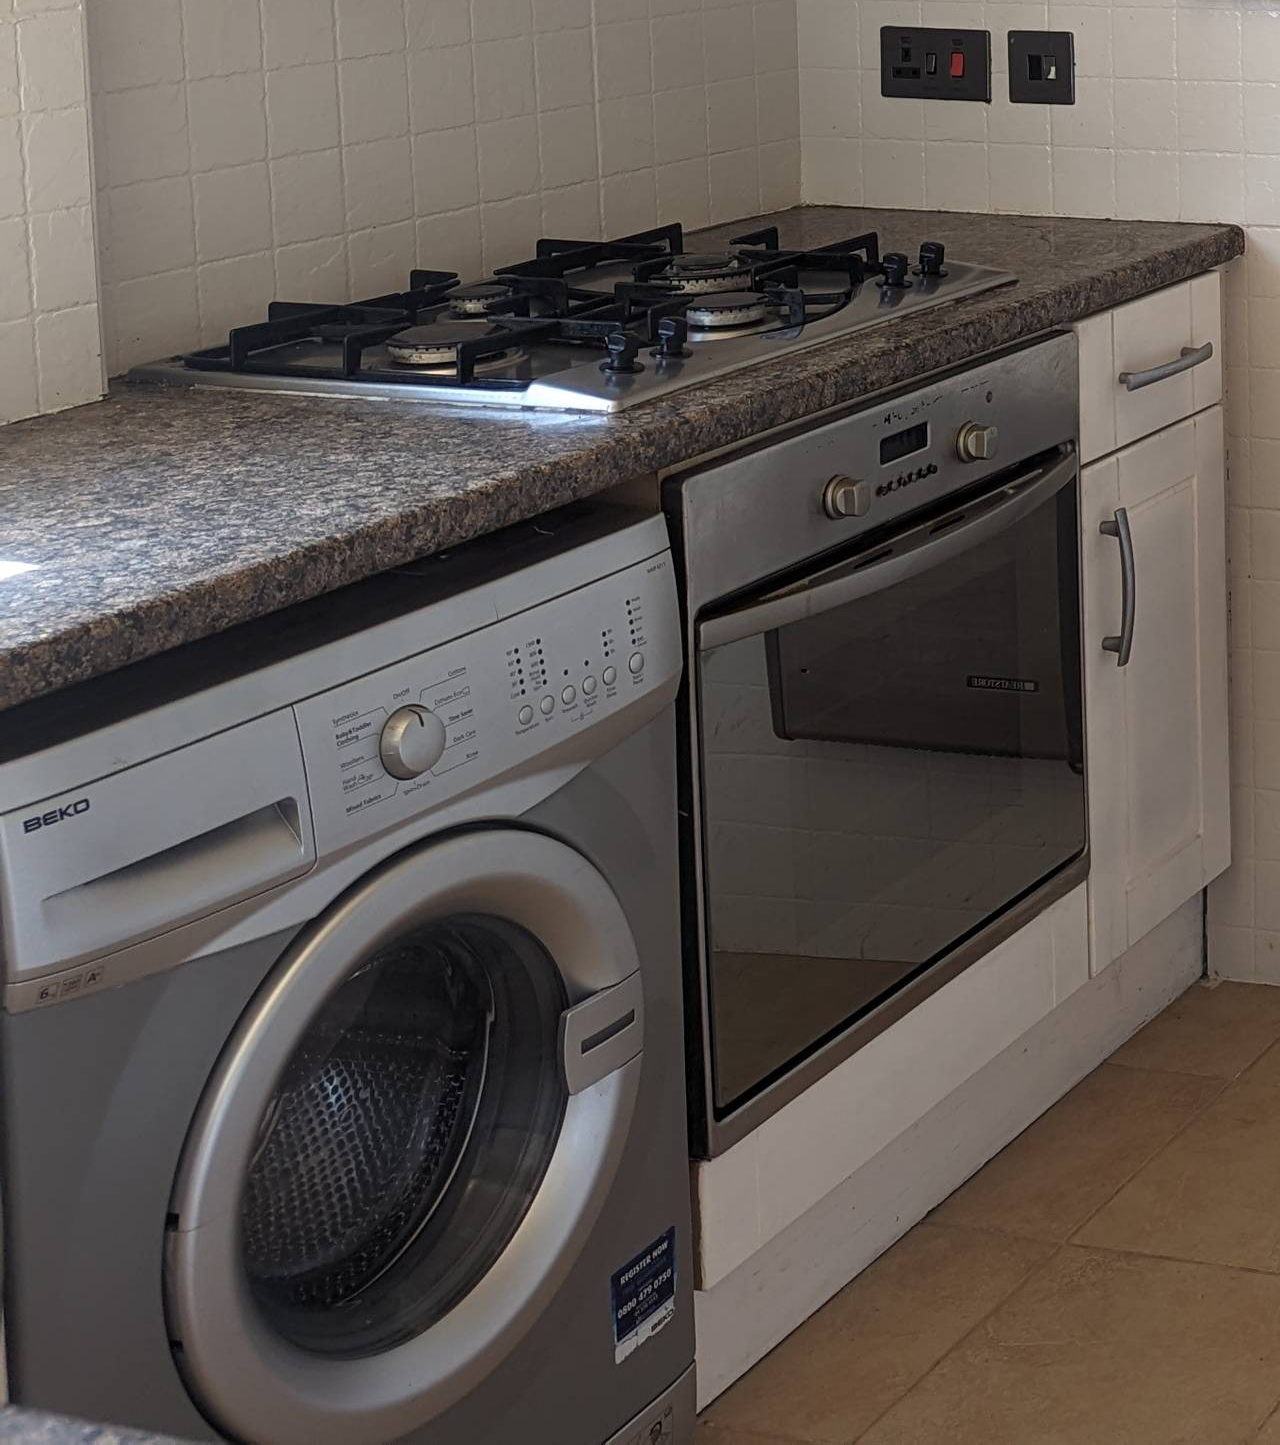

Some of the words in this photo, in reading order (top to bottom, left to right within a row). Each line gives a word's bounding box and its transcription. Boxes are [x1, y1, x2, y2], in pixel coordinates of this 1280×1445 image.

[22, 798, 90, 834] BEKO
[620, 1254, 651, 1285] REGISTER
[652, 1240, 669, 1258] NOW
[617, 1297, 637, 1319] 0800
